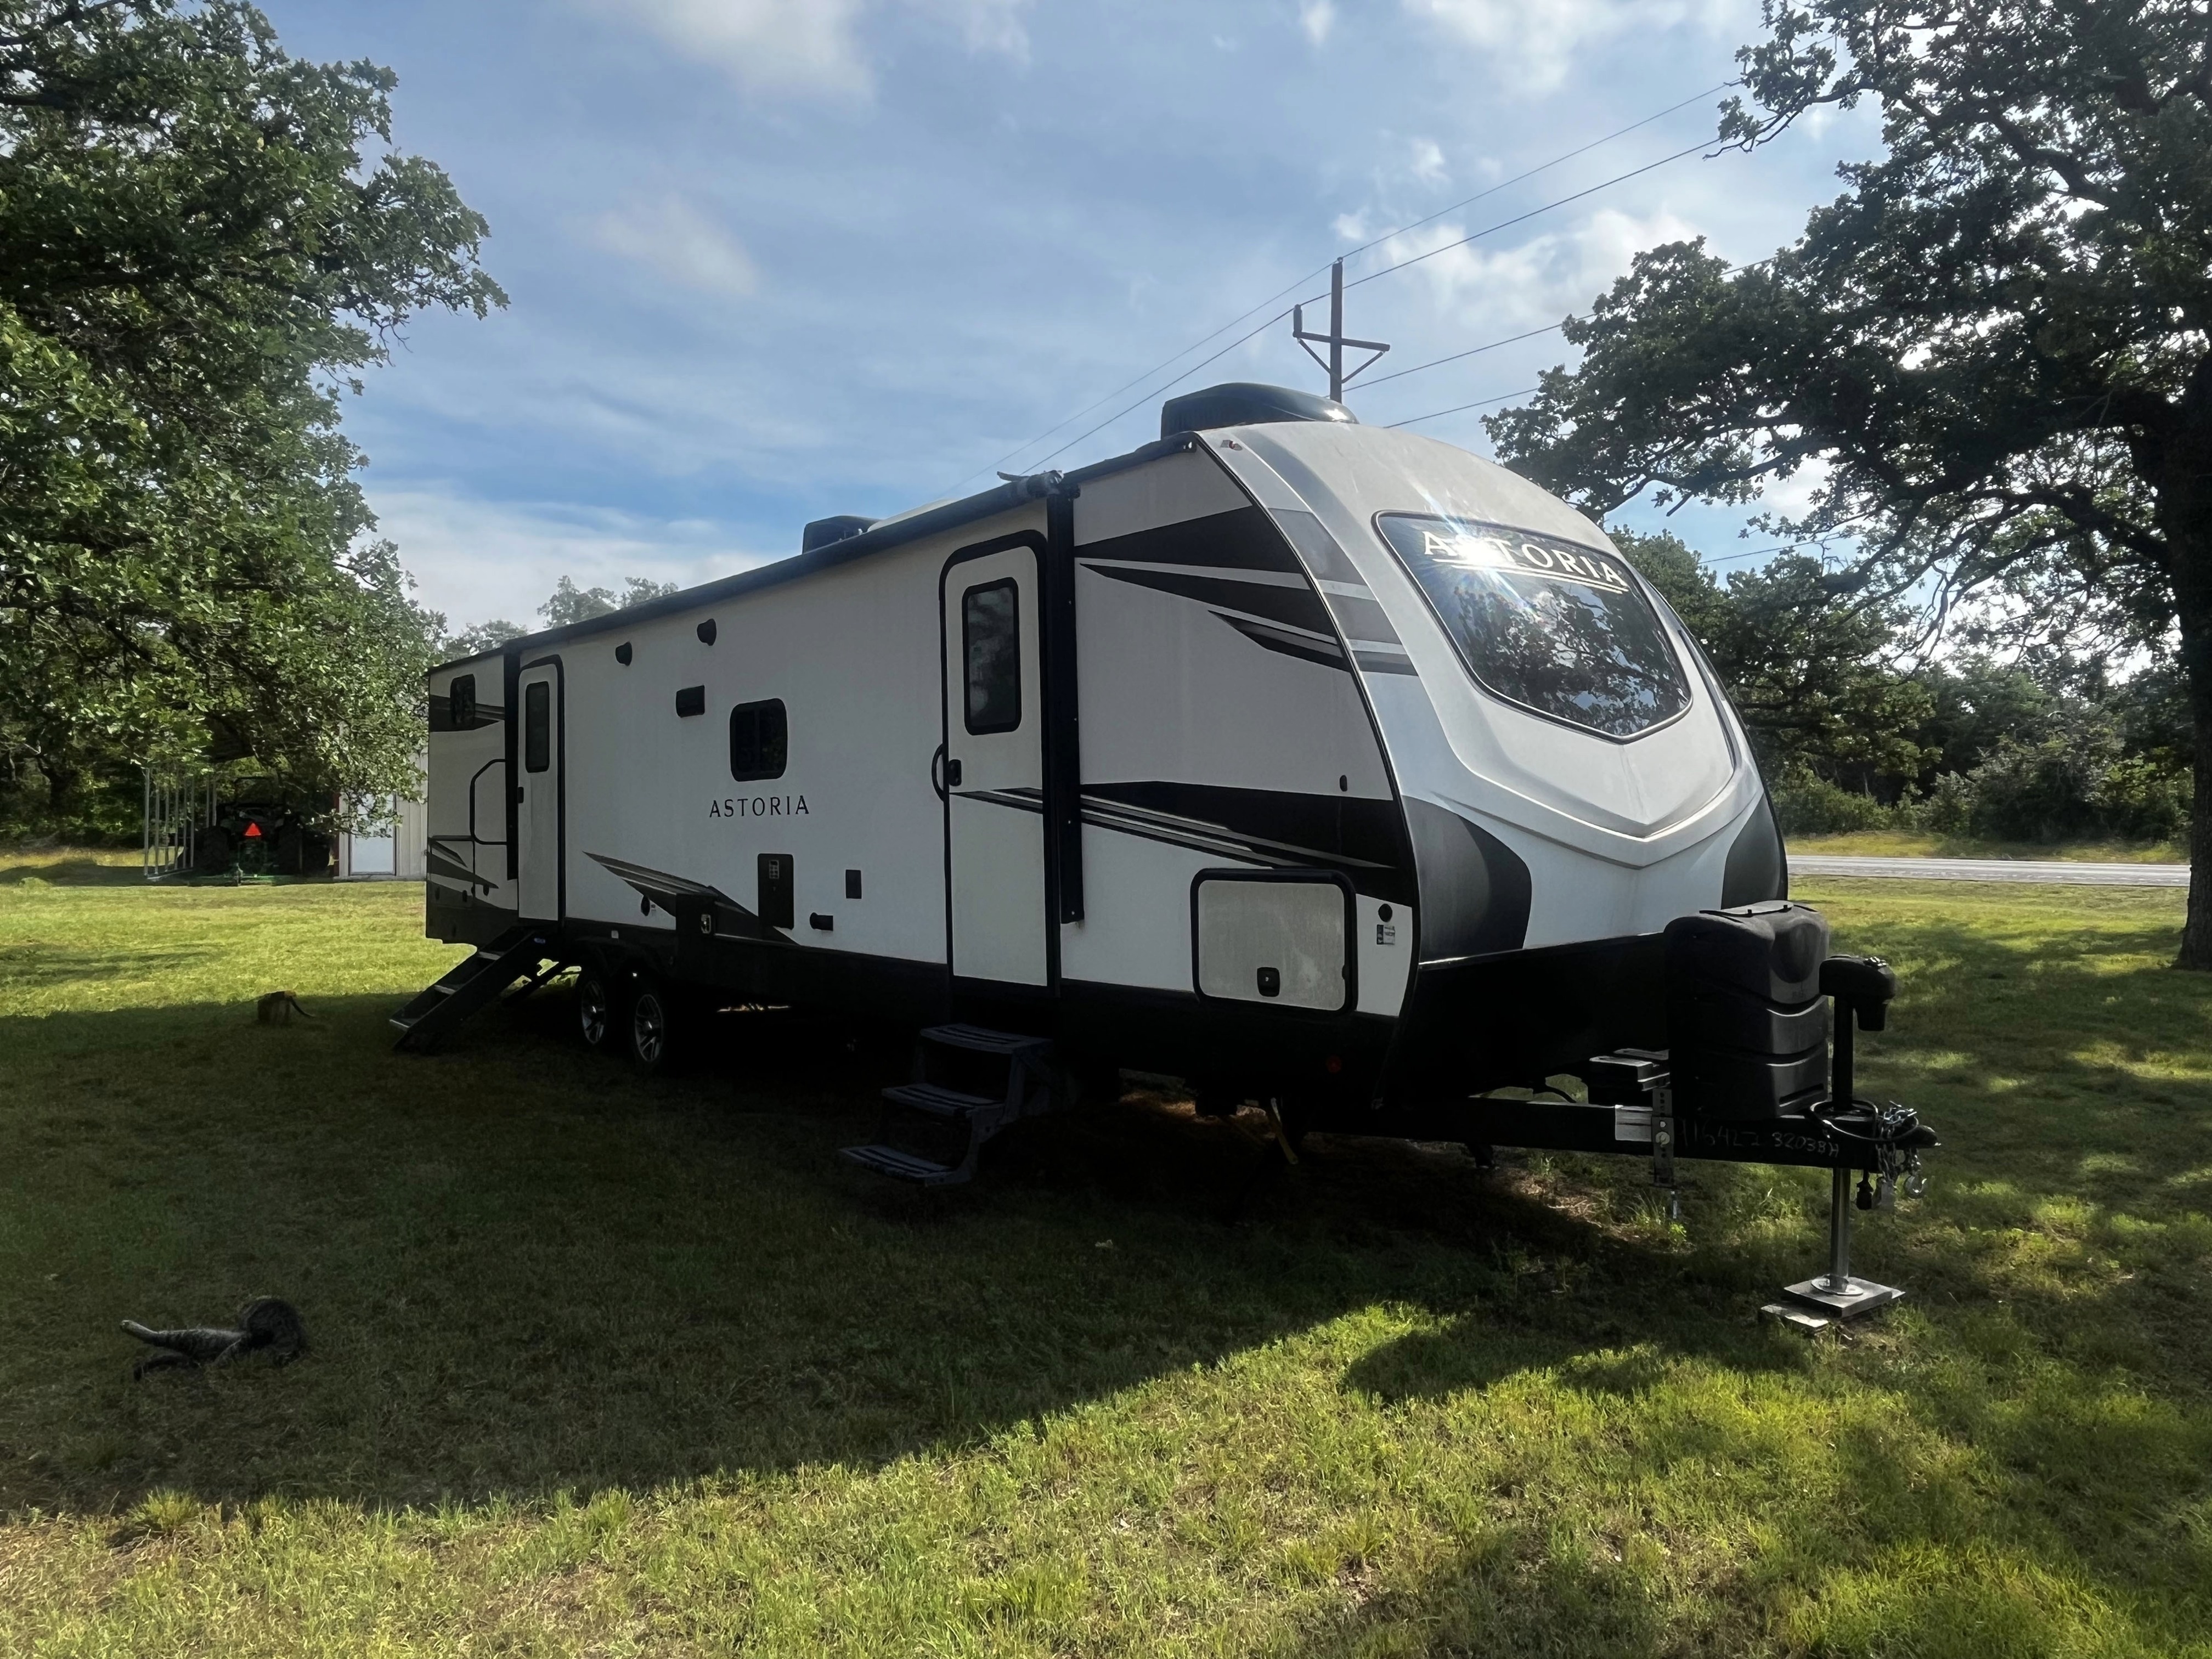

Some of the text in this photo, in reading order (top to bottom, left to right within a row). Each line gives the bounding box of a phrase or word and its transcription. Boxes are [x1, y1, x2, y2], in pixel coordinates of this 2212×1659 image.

[1422, 531, 1628, 587] ATORIA
[709, 795, 809, 817] ASTORIA
[1772, 1132, 1839, 1158] 3203BH
